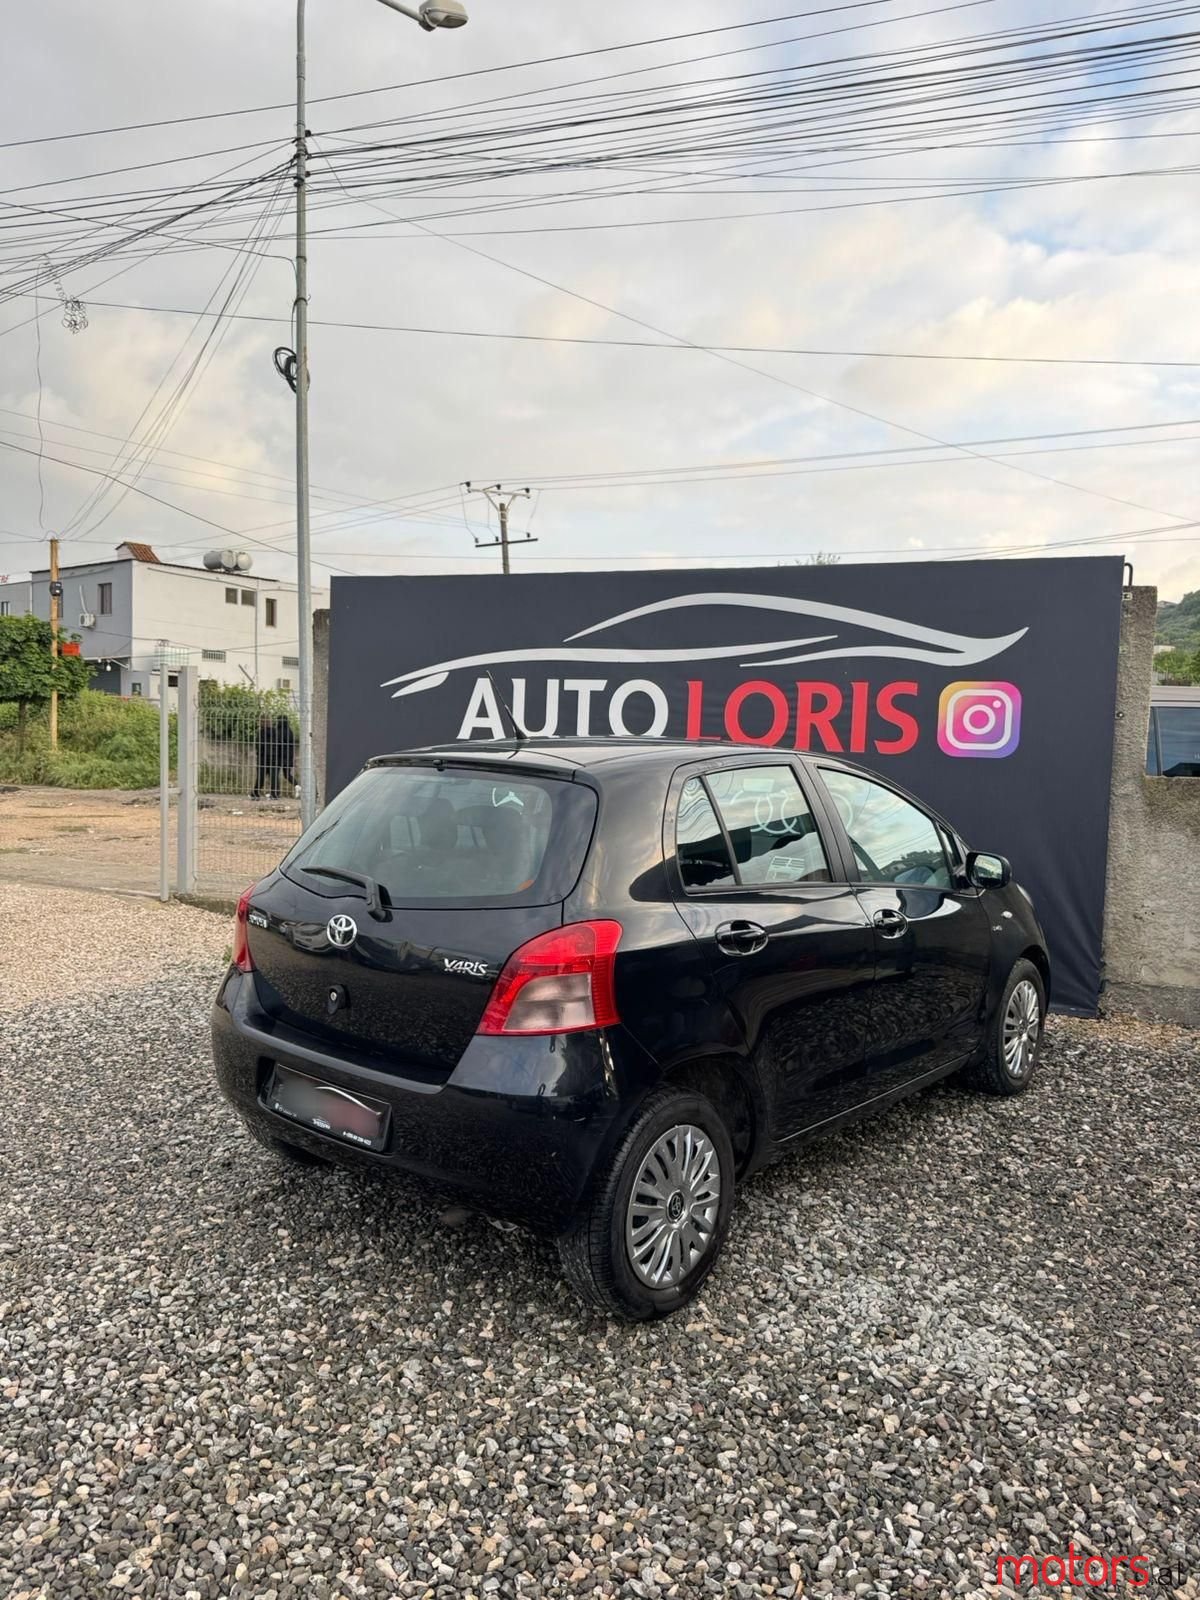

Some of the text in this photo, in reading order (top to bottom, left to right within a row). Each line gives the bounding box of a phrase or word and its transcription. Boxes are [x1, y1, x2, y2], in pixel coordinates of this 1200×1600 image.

[456, 678, 920, 755] AUTO LORIS
[443, 958, 489, 976] YARIS
